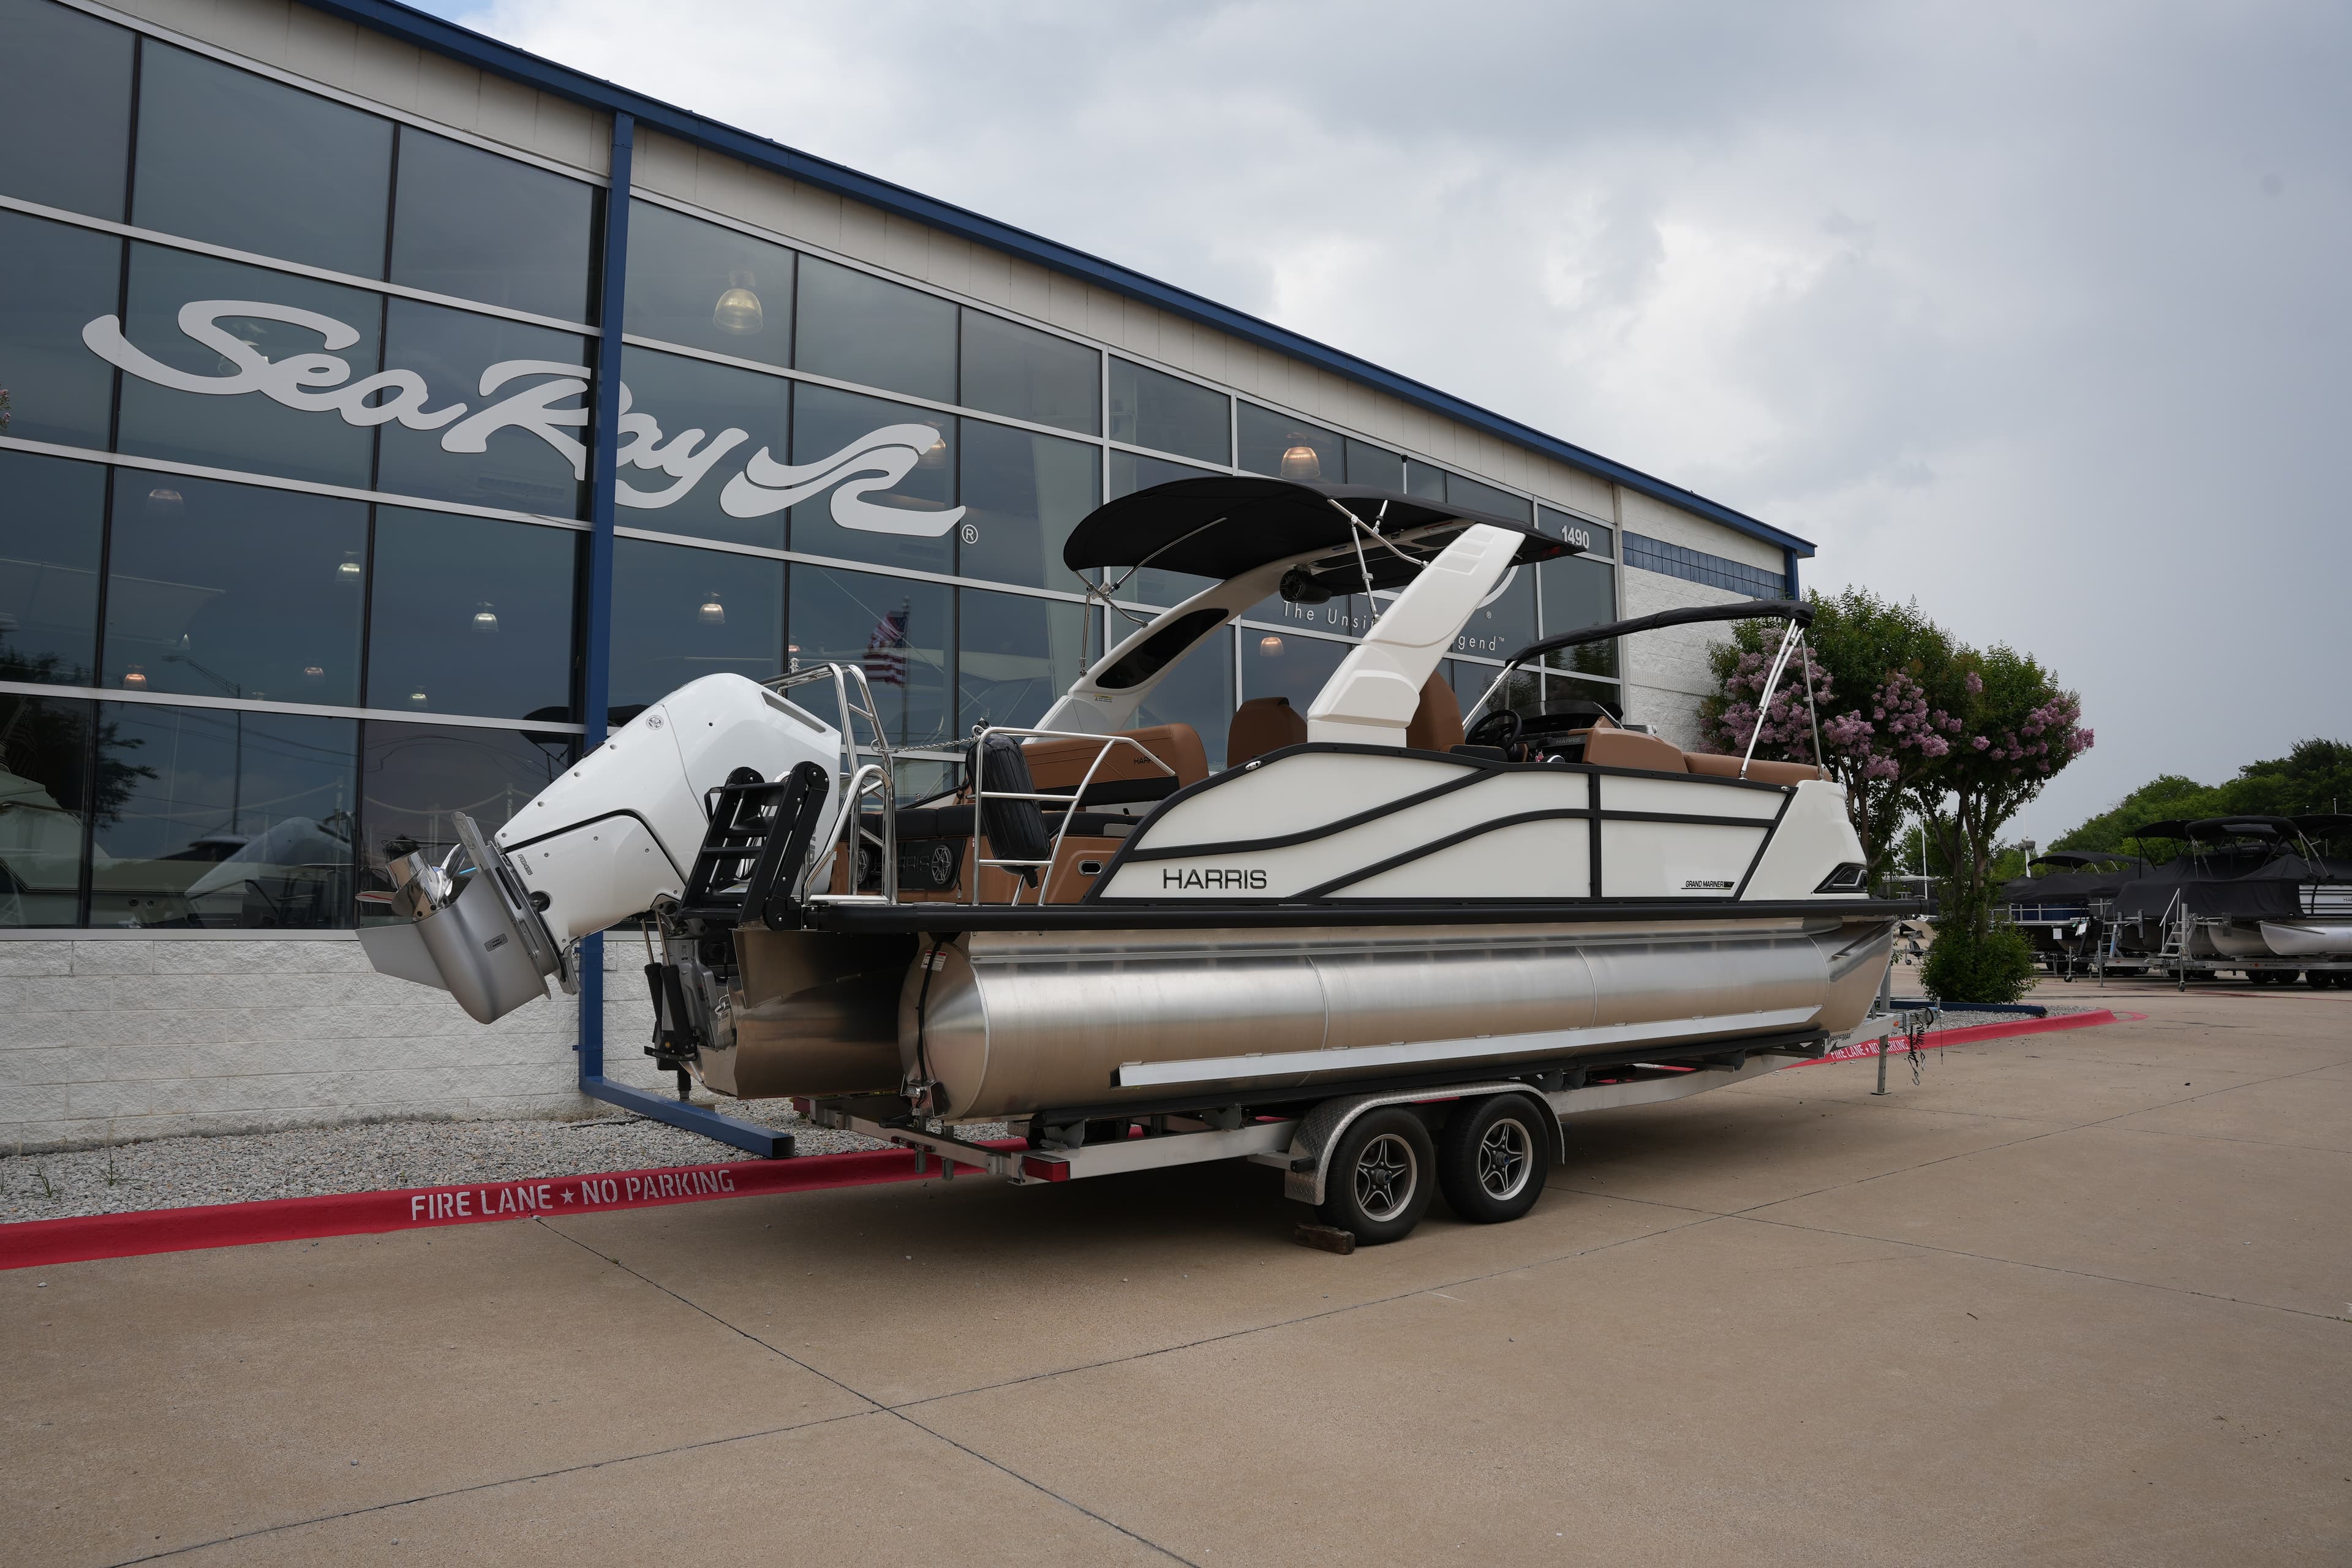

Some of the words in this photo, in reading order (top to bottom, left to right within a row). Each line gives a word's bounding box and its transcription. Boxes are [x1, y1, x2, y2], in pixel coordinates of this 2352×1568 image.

[82, 299, 467, 431] Sea
[441, 359, 749, 508] Ray
[1561, 525, 1589, 549] 1490
[1283, 600, 1314, 621] The
[1328, 608, 1375, 630] Unsi
[872, 855, 930, 873] HRRIS
[1163, 869, 1267, 889] HARRIS
[1830, 1049, 1847, 1060] FIRE
[1846, 1044, 1866, 1057] LANE
[1869, 1042, 1880, 1054] NO
[411, 1190, 471, 1221] FIRE
[480, 1184, 552, 1215] LANE
[581, 1178, 618, 1205] NO
[625, 1169, 734, 1202] PARKING
